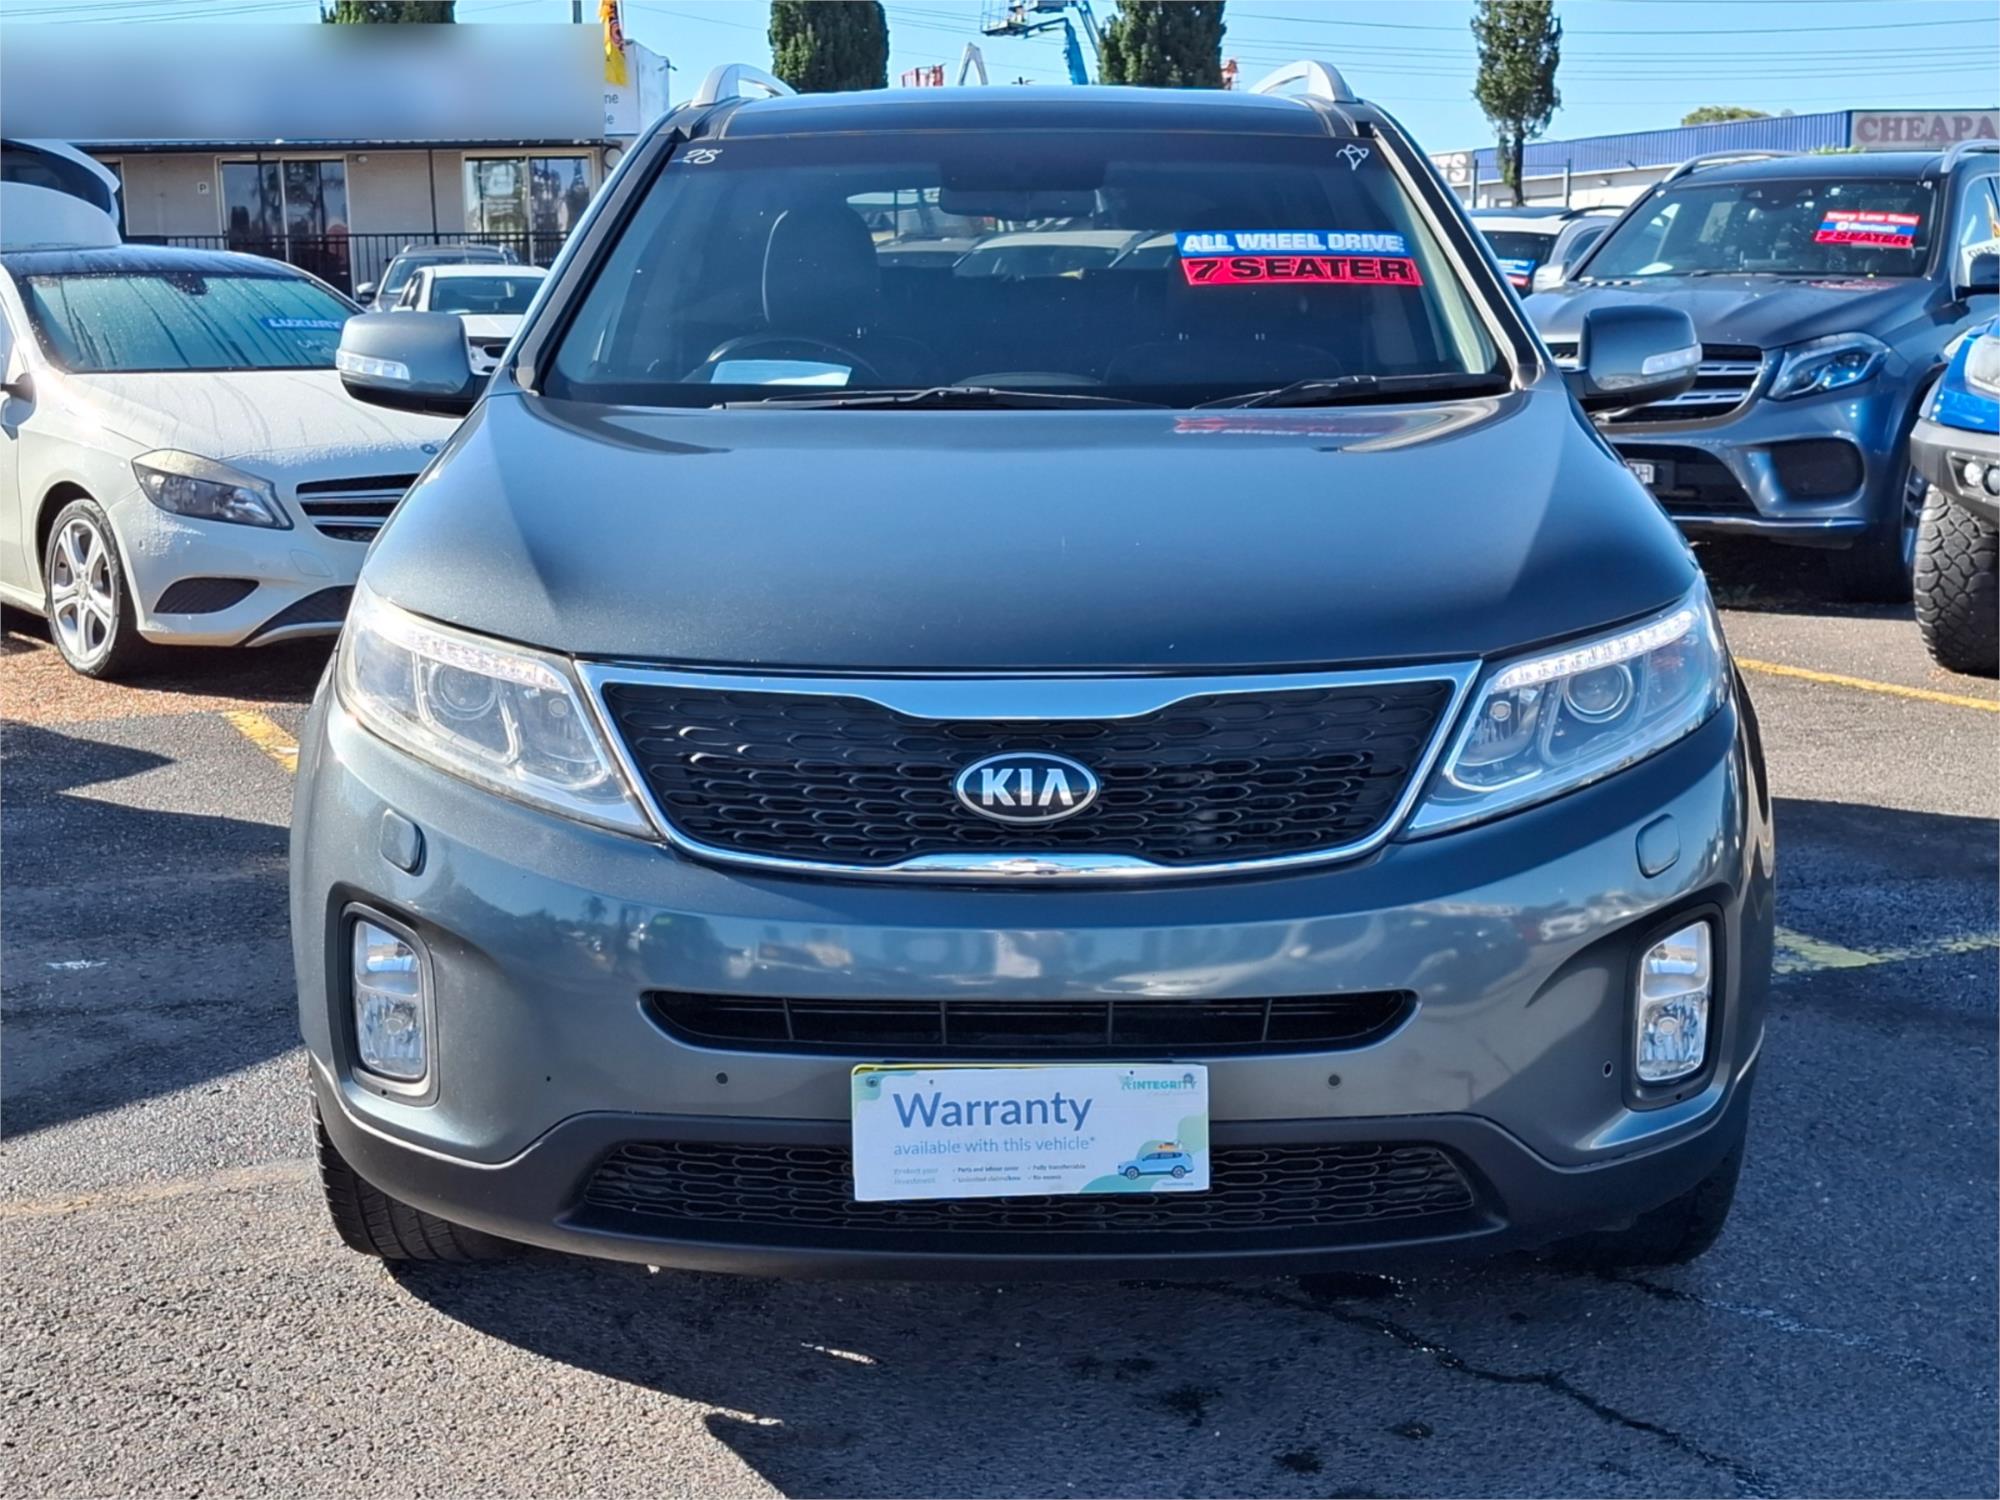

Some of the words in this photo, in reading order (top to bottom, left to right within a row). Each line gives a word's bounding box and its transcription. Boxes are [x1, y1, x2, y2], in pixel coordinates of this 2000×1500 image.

[1184, 233, 1235, 252] ALL
[1235, 233, 1327, 251] WHEEL
[1328, 234, 1405, 253] DRIVE
[1188, 259, 1219, 279] 7
[1230, 259, 1413, 279] SEATER
[268, 318, 342, 329] LUXURY
[980, 768, 1074, 806] KIA
[892, 1091, 1093, 1131] Warranty
[893, 1140, 960, 1156] available
[964, 1138, 999, 1153] with
[1003, 1137, 1031, 1152] this
